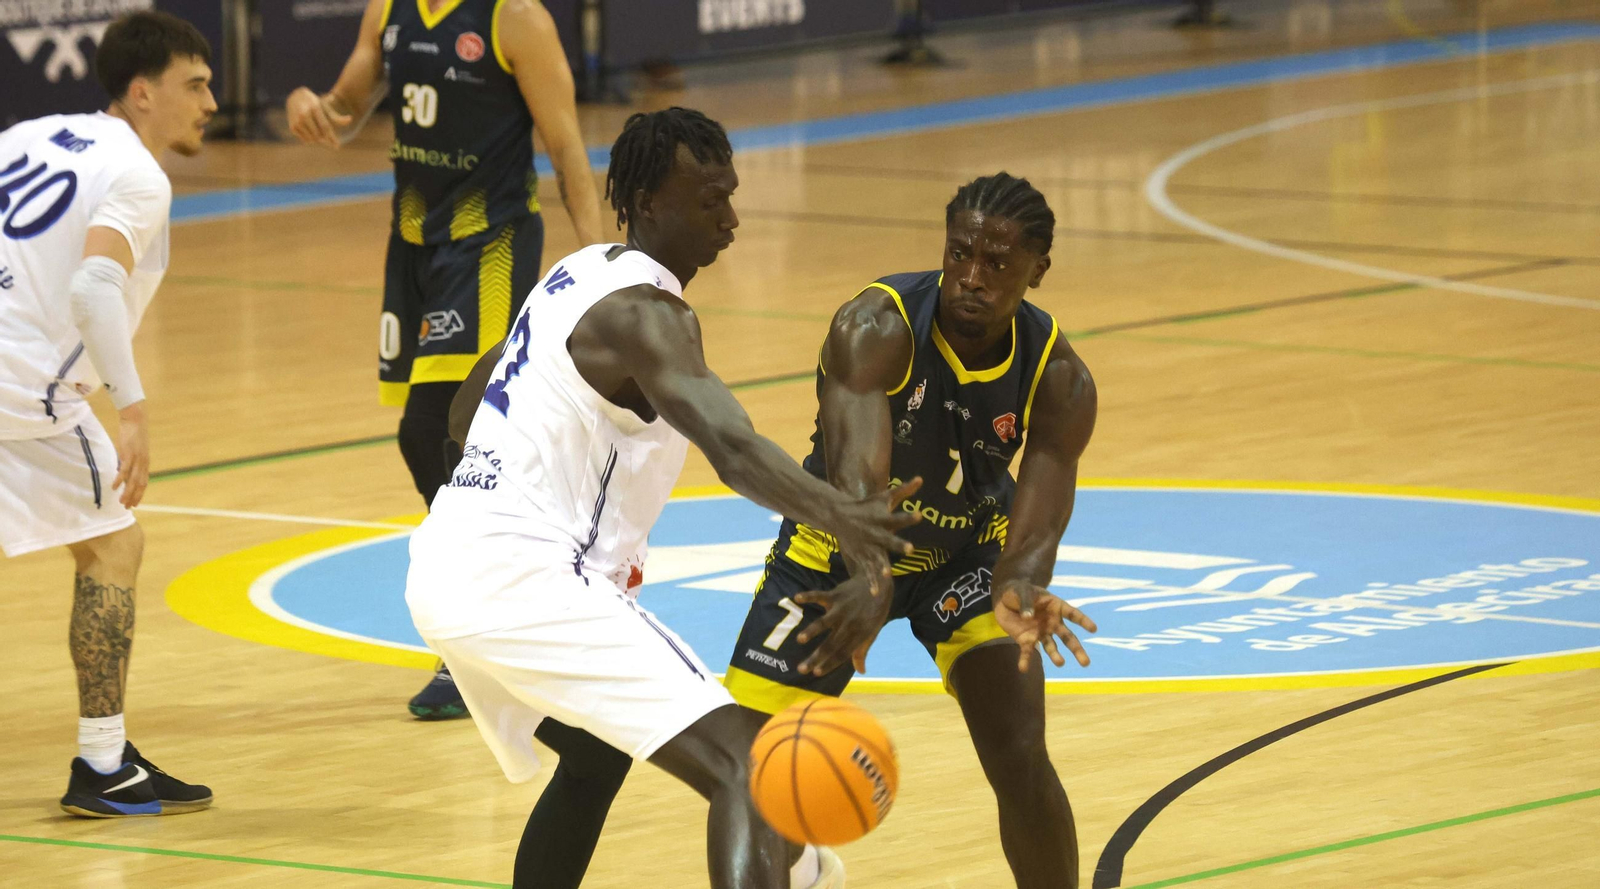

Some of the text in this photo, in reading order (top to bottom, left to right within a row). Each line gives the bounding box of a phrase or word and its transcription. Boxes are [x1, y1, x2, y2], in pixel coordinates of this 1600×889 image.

[402, 83, 438, 127] 30
[1244, 573, 1600, 652] de Algecira
